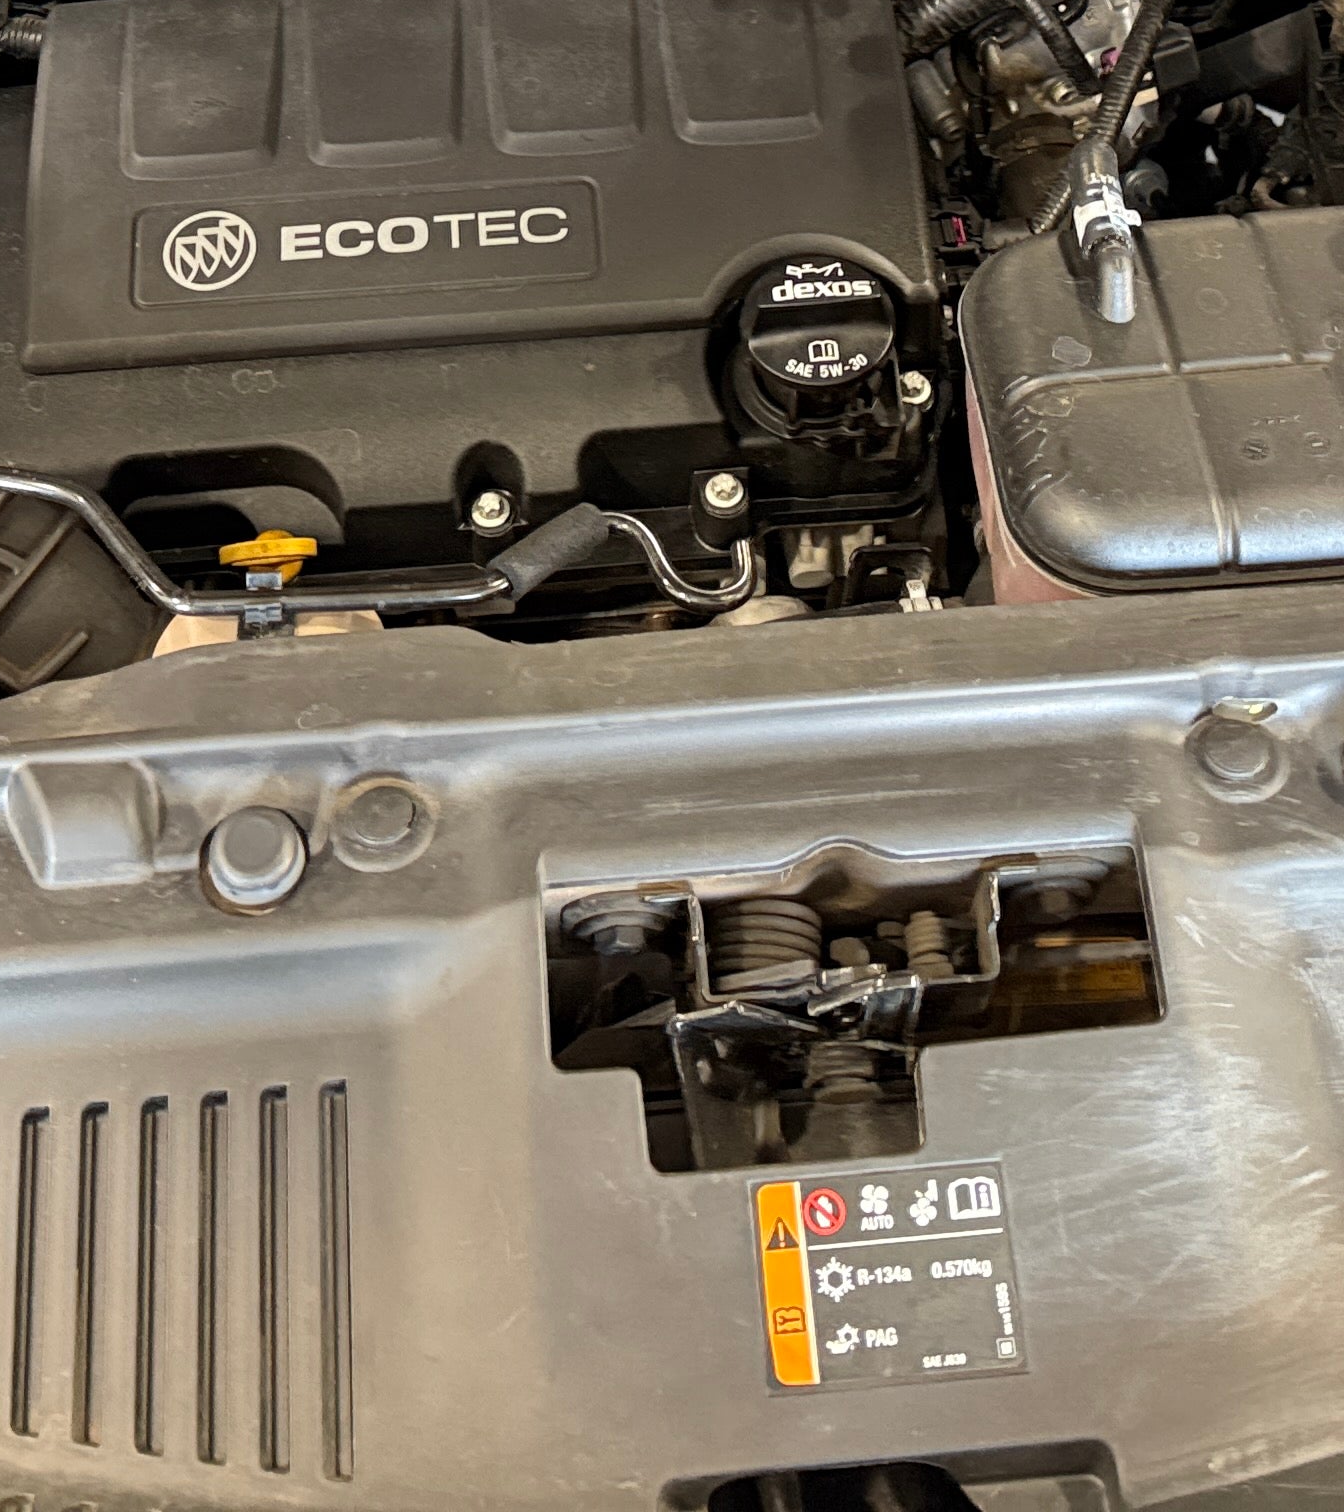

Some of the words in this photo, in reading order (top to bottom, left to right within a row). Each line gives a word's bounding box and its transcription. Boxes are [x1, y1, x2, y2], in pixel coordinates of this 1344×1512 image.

[280, 207, 568, 262] ECOTEC
[771, 279, 873, 302] dexos
[785, 358, 813, 378] SAE
[819, 353, 868, 378] 5W-30
[860, 1214, 895, 1231] AUTO
[856, 1265, 913, 1286] R-134a
[930, 1257, 993, 1279] 0.570kg
[864, 1326, 899, 1348] PAG
